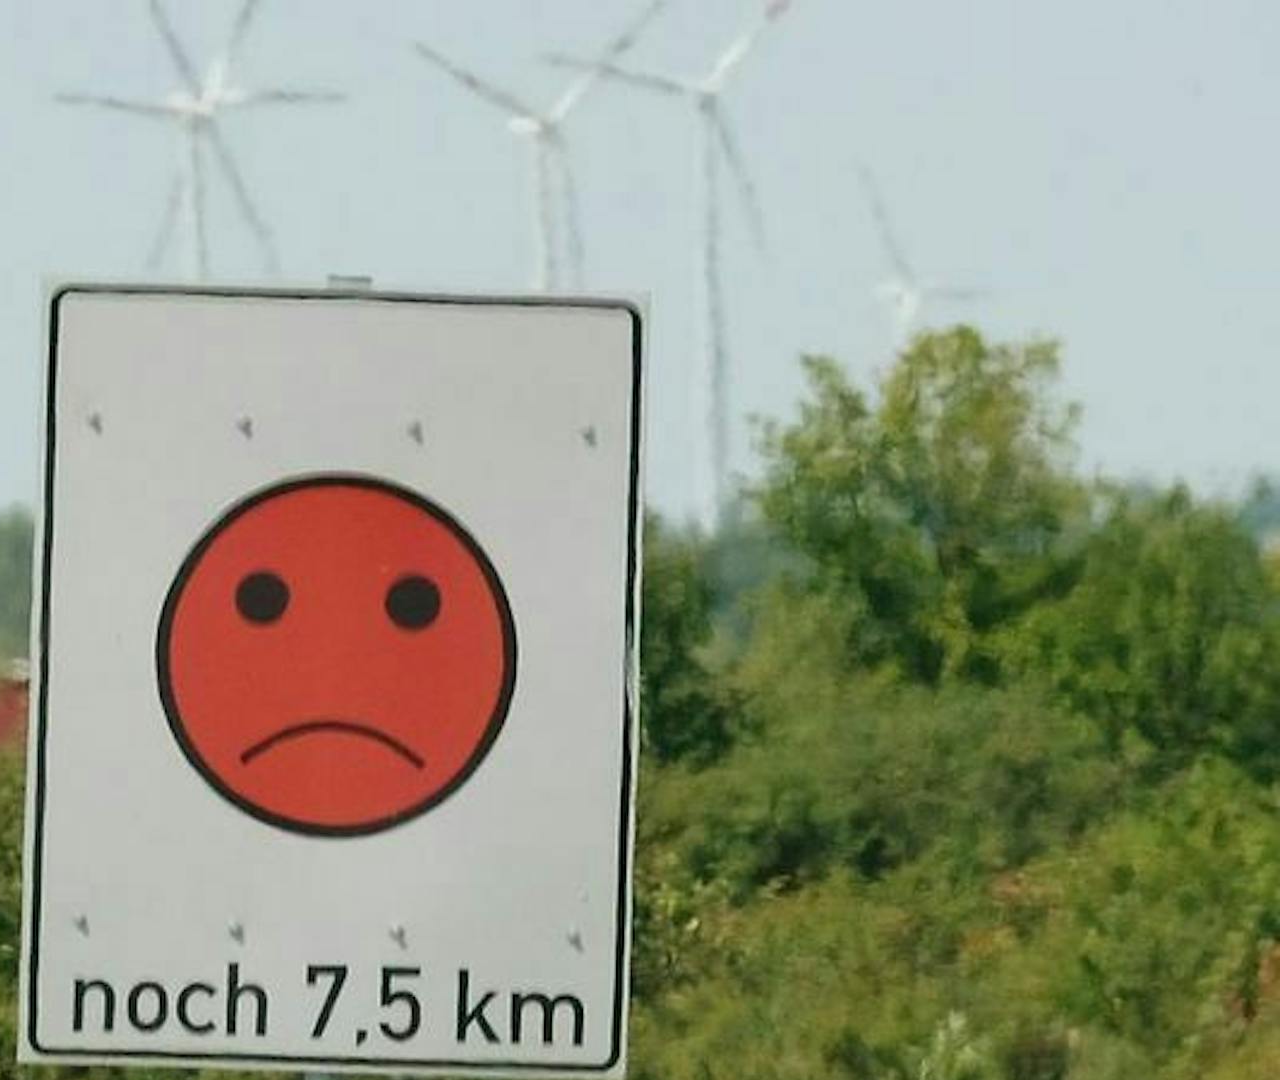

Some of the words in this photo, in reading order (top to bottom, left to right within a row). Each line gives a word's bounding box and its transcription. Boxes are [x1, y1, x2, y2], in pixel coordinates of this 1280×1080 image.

[73, 963, 267, 1036] noch
[306, 965, 421, 1046] 7,5
[457, 969, 584, 1045] km
